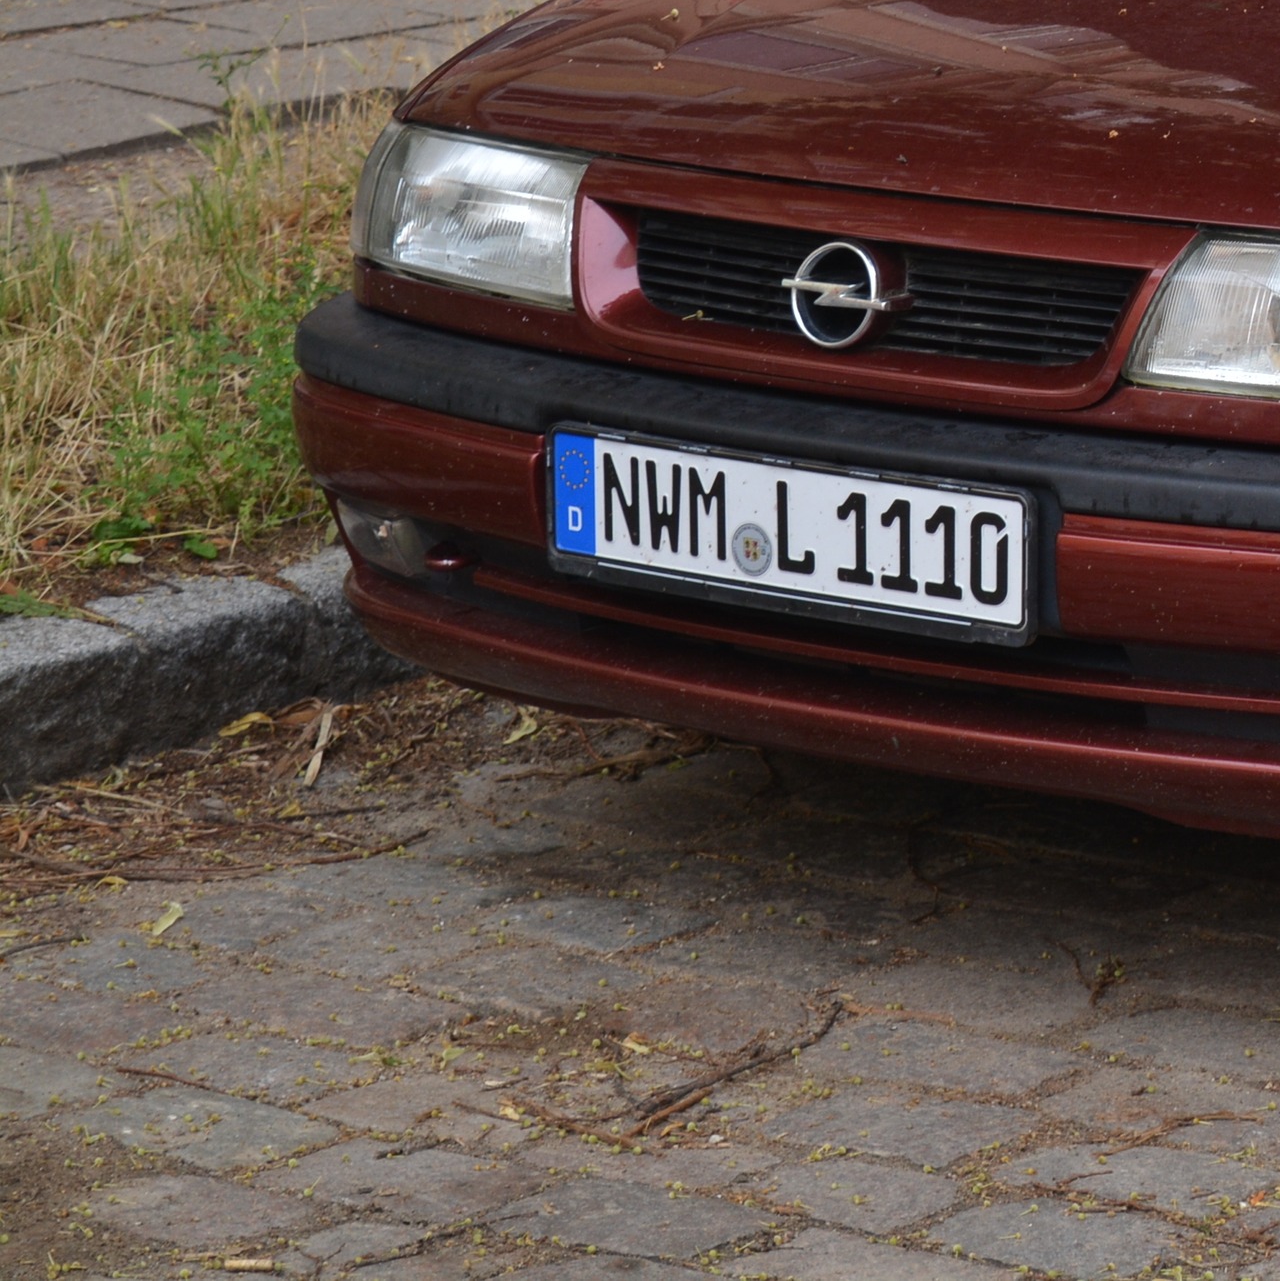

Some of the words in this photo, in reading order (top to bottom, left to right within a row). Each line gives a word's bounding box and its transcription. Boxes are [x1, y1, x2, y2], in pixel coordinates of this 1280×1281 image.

[567, 505, 582, 532] D
[602, 451, 727, 562] NWM
[776, 479, 816, 575] L
[836, 491, 1009, 606] 1110
